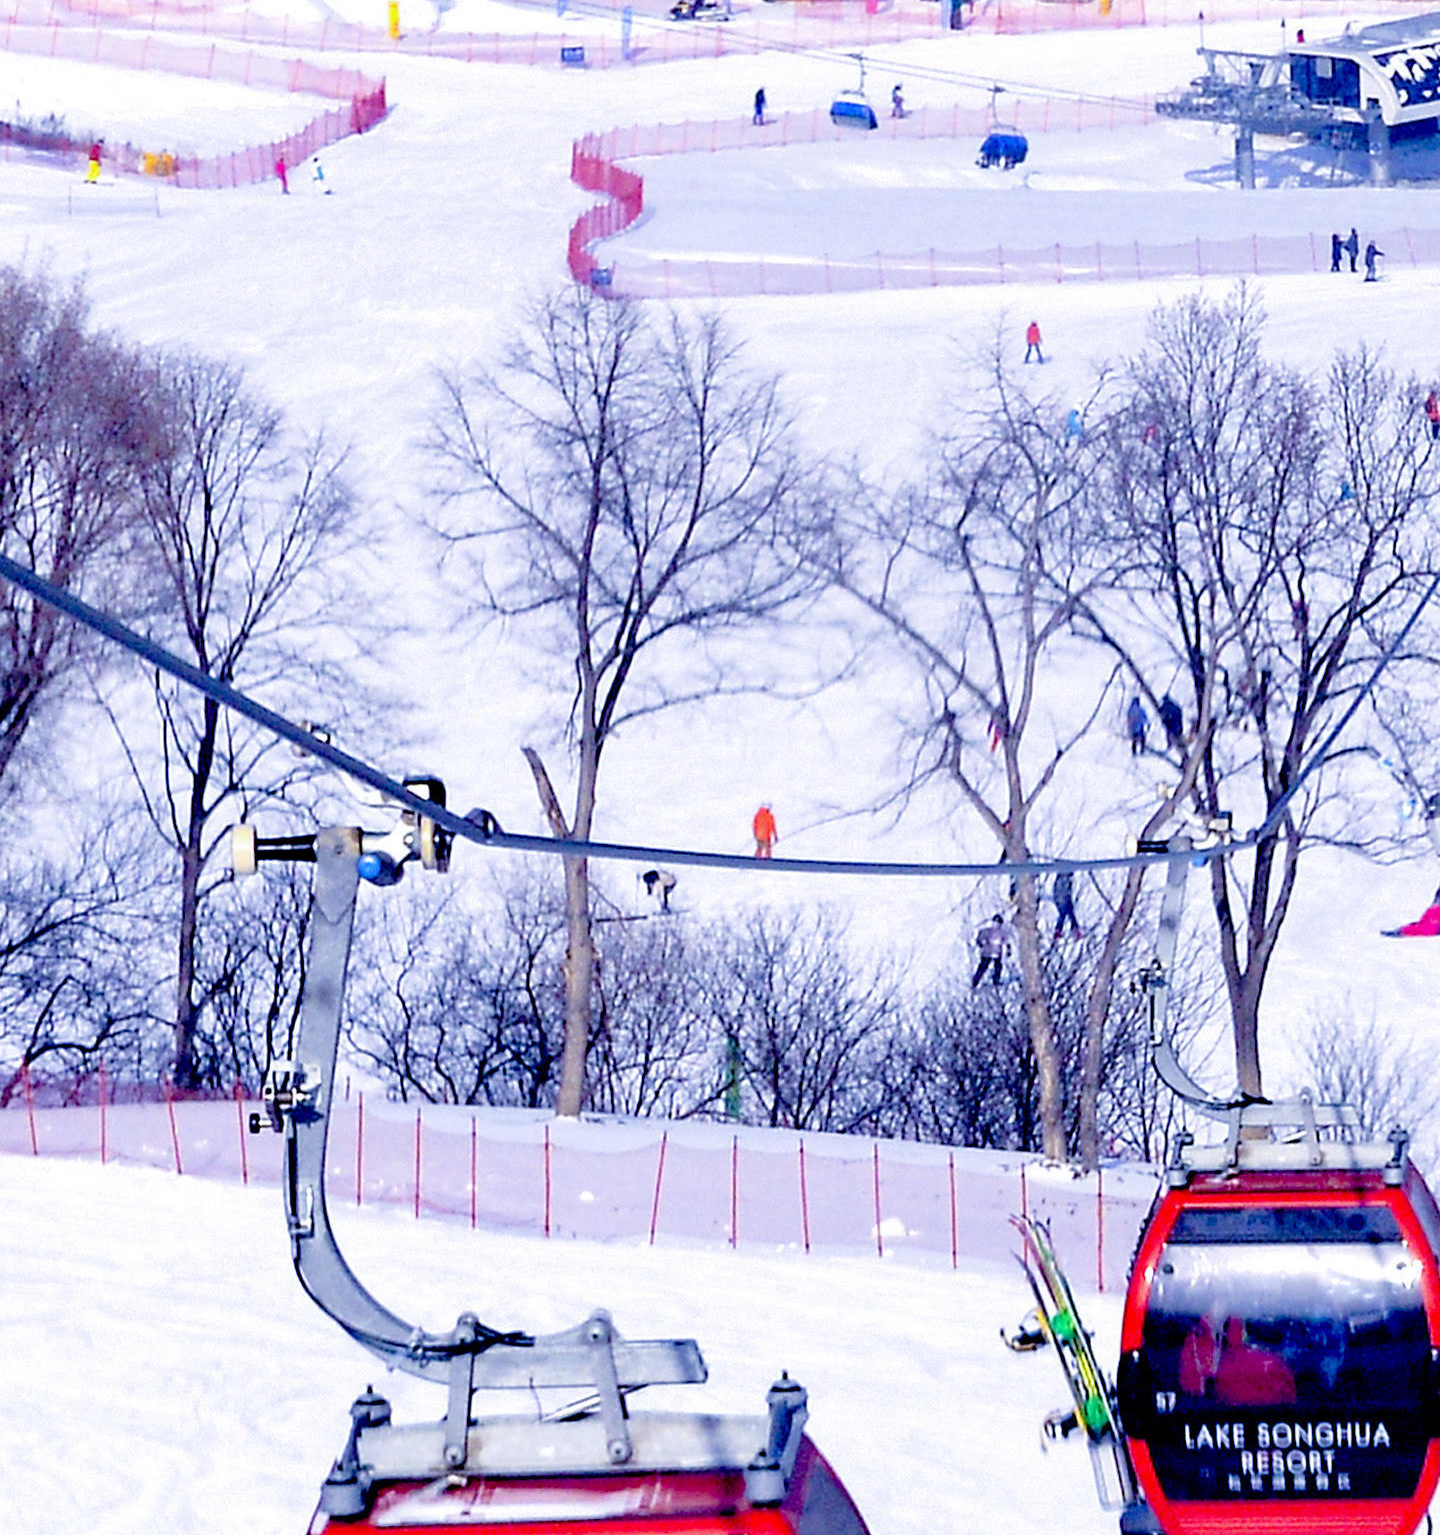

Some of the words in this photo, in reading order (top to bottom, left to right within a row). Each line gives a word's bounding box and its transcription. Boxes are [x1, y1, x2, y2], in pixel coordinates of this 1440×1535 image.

[1184, 1422, 1246, 1450] LAKE
[1257, 1421, 1391, 1449] SONGHUA
[1241, 1449, 1335, 1475] RESORT
